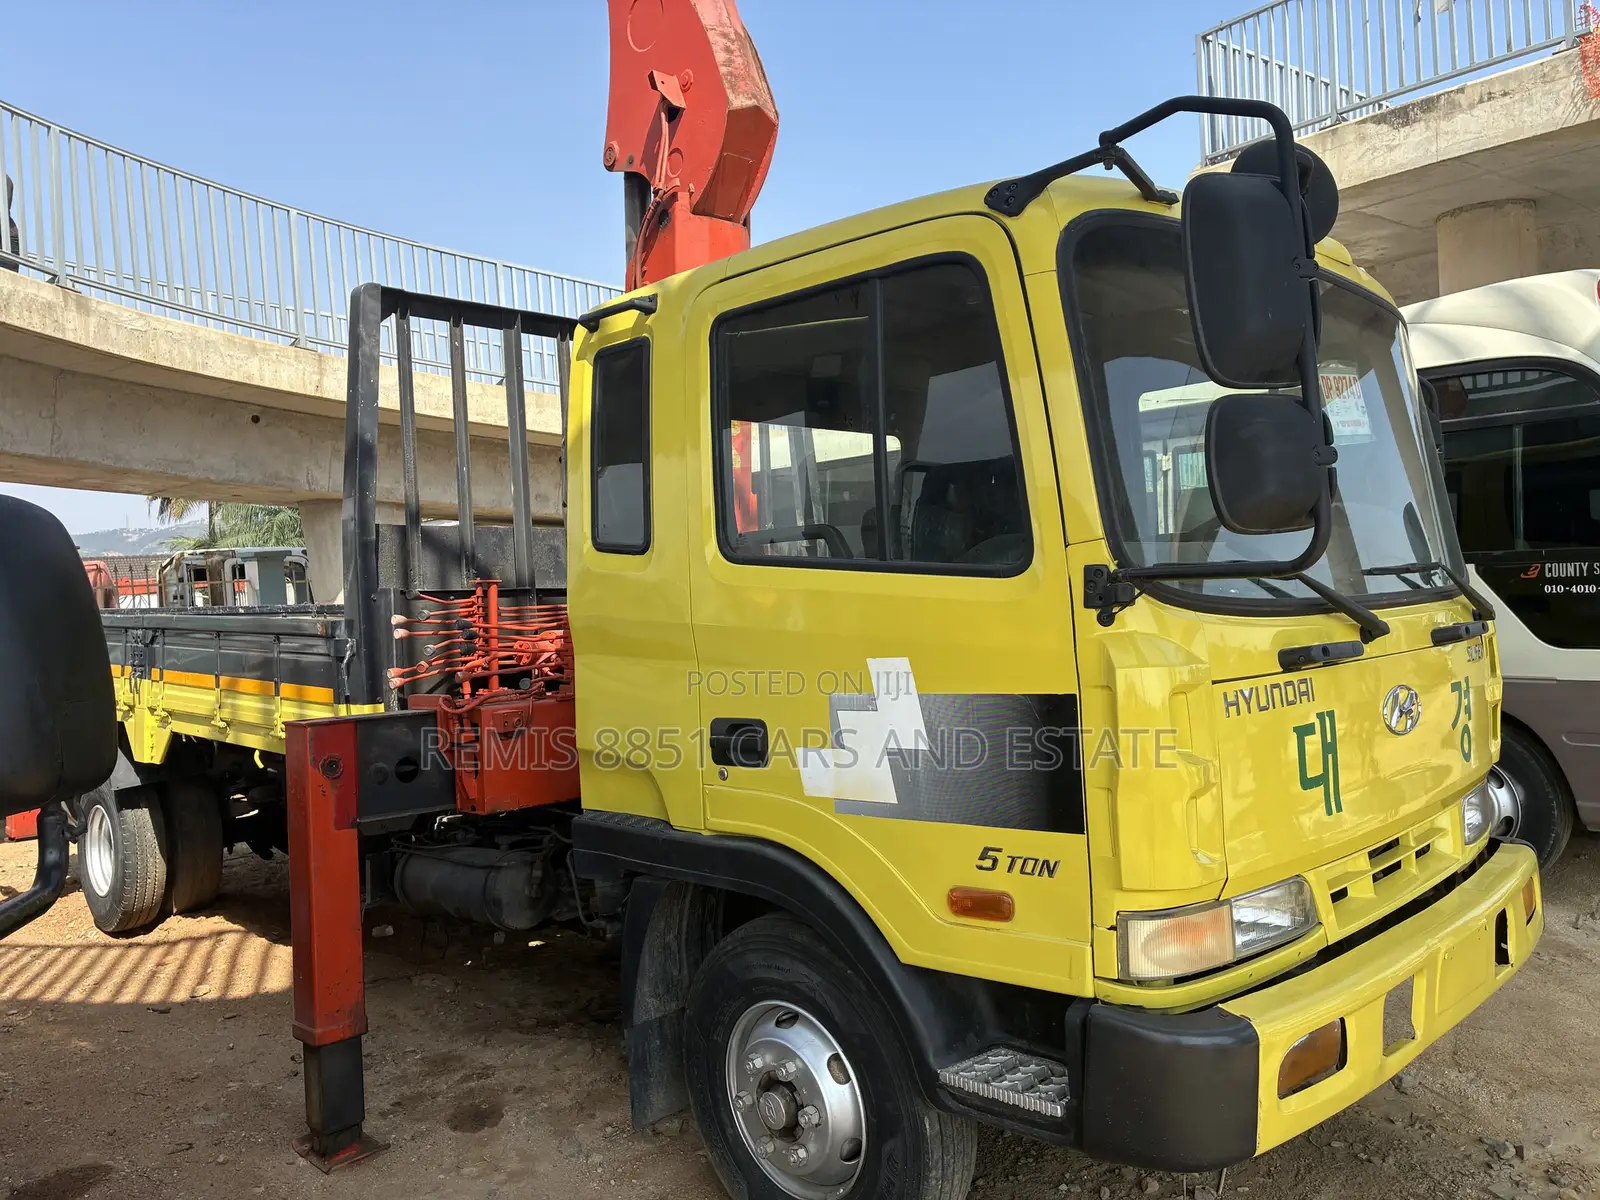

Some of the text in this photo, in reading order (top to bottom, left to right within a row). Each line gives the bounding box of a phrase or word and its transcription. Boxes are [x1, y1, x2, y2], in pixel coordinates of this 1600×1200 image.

[1544, 562, 1589, 578] COUNTY
[1222, 677, 1316, 718] HYUNDAI
[1292, 675, 1472, 816] 대 경
[975, 845, 1062, 879] 5 TON
